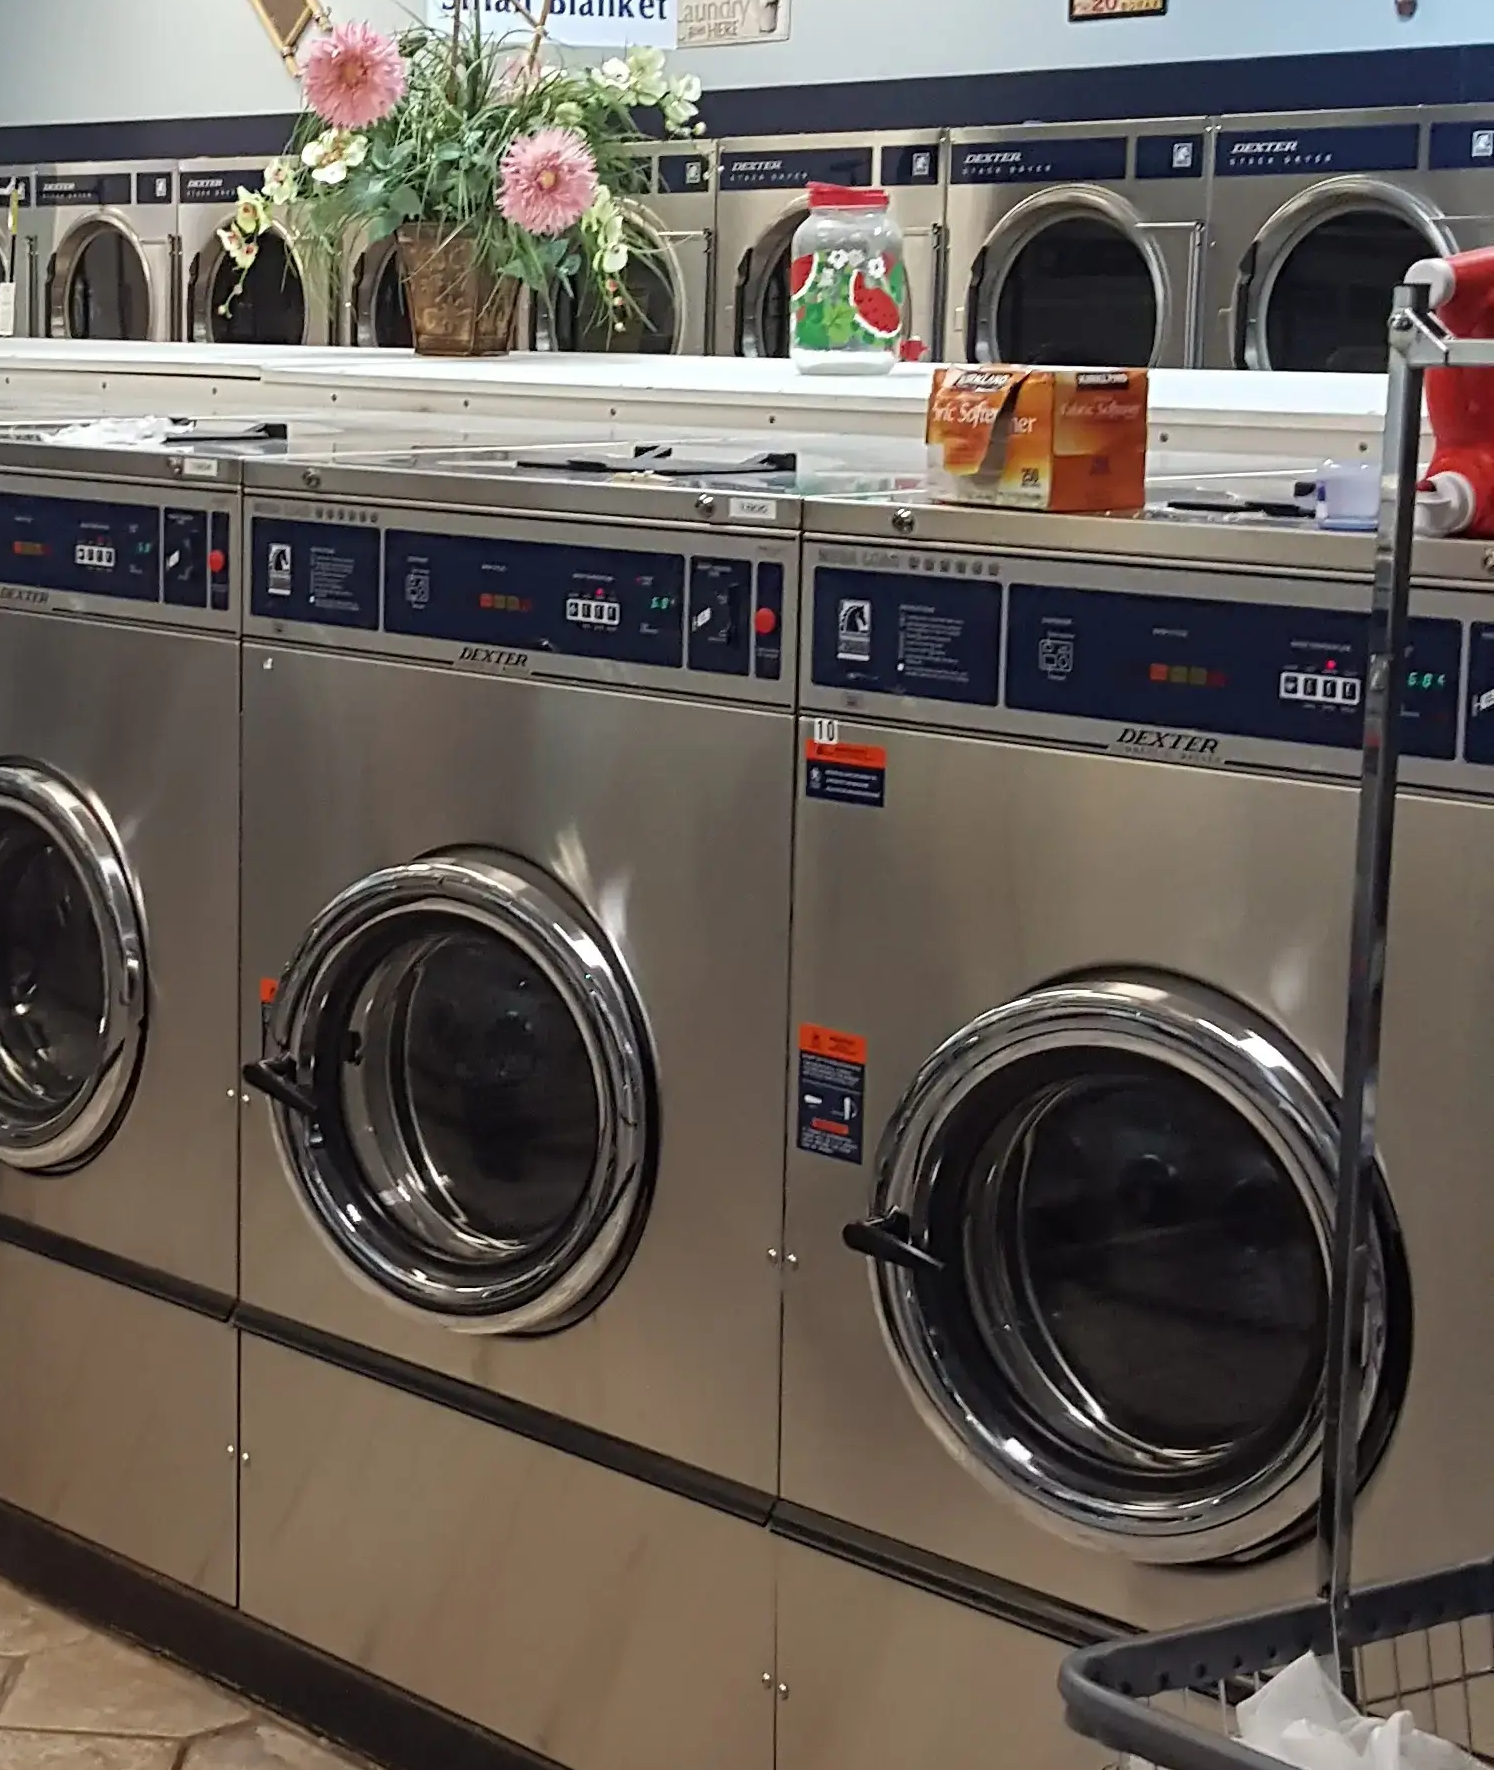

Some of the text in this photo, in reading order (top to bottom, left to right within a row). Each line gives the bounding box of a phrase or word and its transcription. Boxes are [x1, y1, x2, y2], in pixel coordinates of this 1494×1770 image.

[1231, 140, 1299, 155] DEXTER
[732, 160, 783, 172] DEXTER
[963, 151, 1022, 165] DEXTER
[458, 647, 528, 667] DEXTER
[817, 720, 835, 742] 10
[1117, 727, 1219, 753] DEXTER
